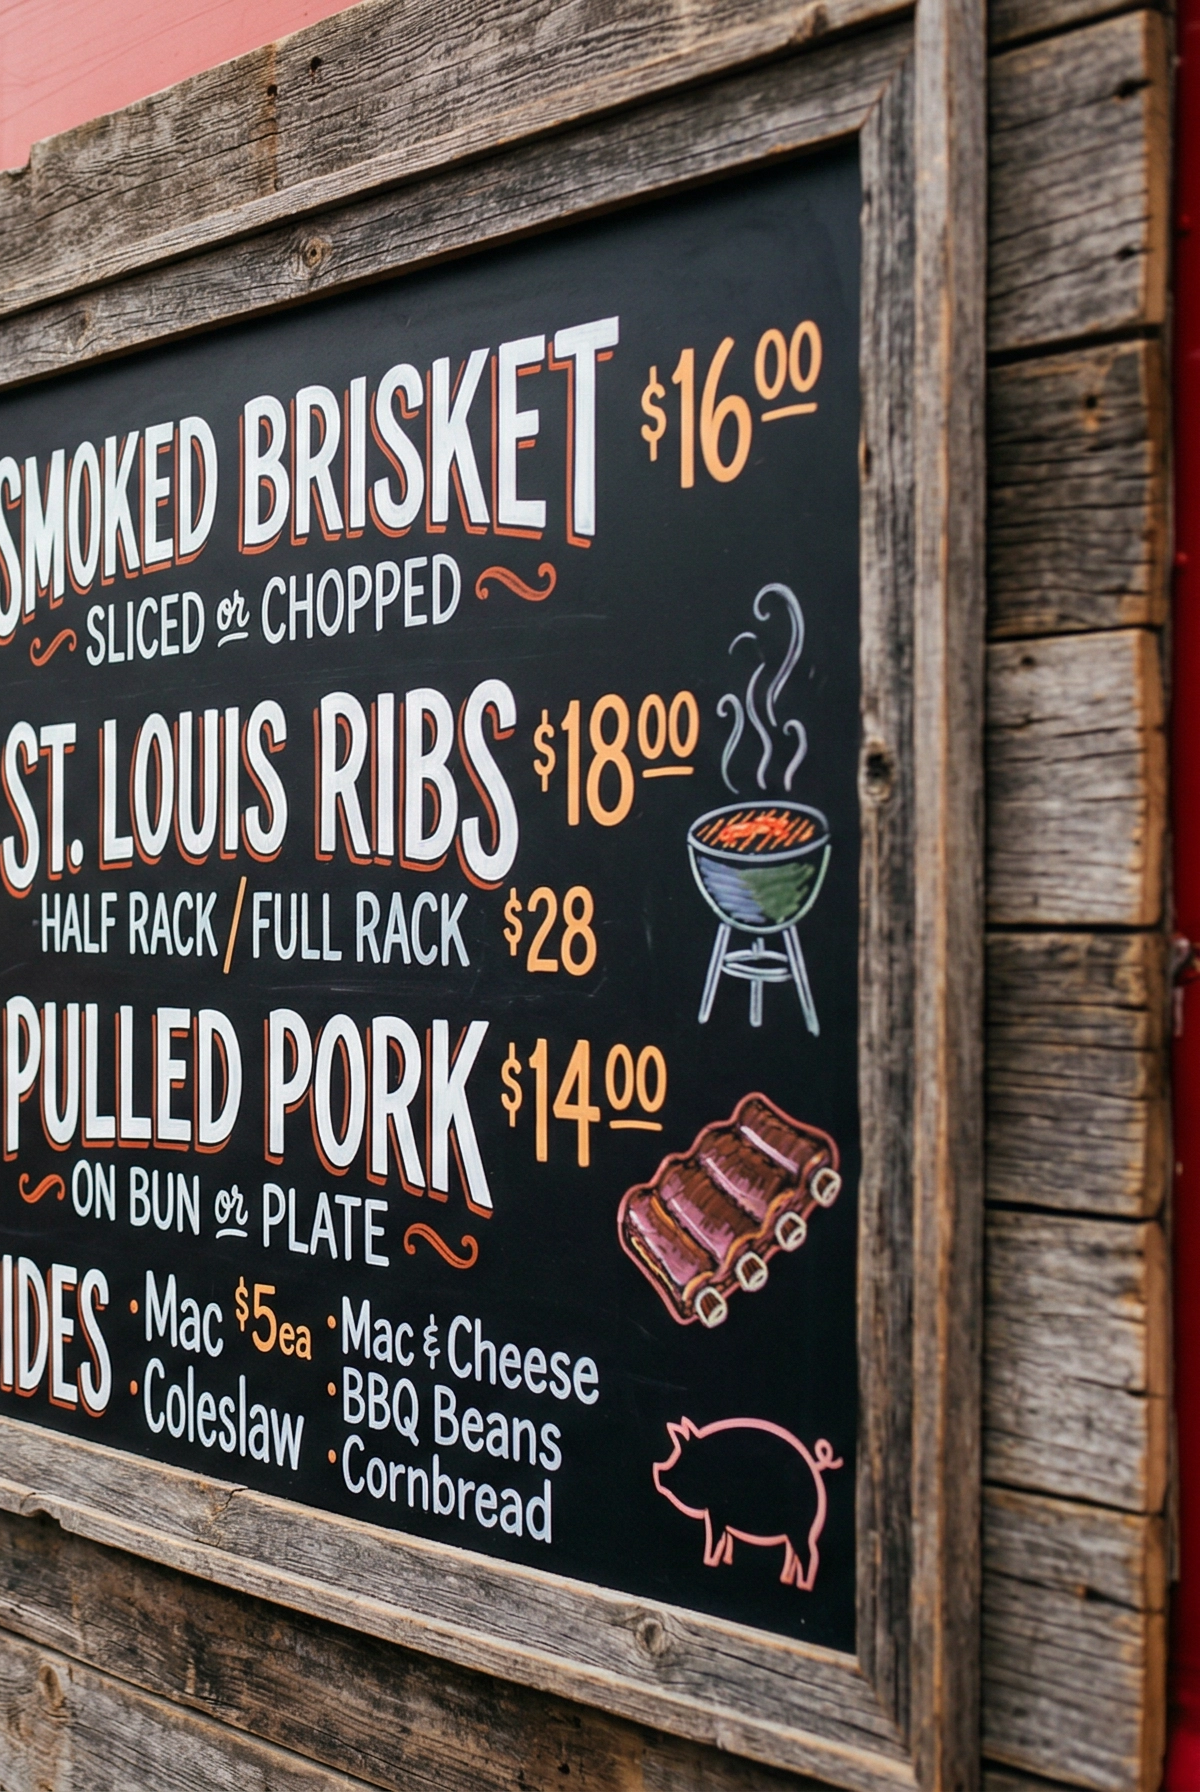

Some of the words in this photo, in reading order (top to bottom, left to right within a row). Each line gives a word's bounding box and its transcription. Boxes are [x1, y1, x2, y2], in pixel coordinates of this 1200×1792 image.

[242, 315, 620, 548] BRISKET
[86, 591, 205, 667] SLICED
[216, 589, 250, 648] or
[261, 553, 462, 645] CHOPPED
[2, 720, 84, 889] ST.
[103, 699, 287, 857] LOUIS
[320, 678, 519, 881] RIBS
[41, 892, 117, 953] HALF
[356, 890, 470, 967] RACK
[503, 886, 598, 976] $28
[6, 996, 243, 1153] PULLED
[269, 1008, 493, 1209] PORK
[71, 1159, 117, 1223] ON
[129, 1173, 200, 1236] BUN
[214, 1184, 249, 1239] or
[263, 1183, 390, 1267] PLATE
[144, 1269, 224, 1358] Mac
[341, 1295, 414, 1367] Mac
[423, 1313, 441, 1370] &
[447, 1314, 600, 1405] Cheese
[143, 1357, 305, 1471] Coleslaw
[341, 1365, 420, 1447] BBQ
[434, 1384, 563, 1472] Beans
[341, 1433, 554, 1545] Cornbread
